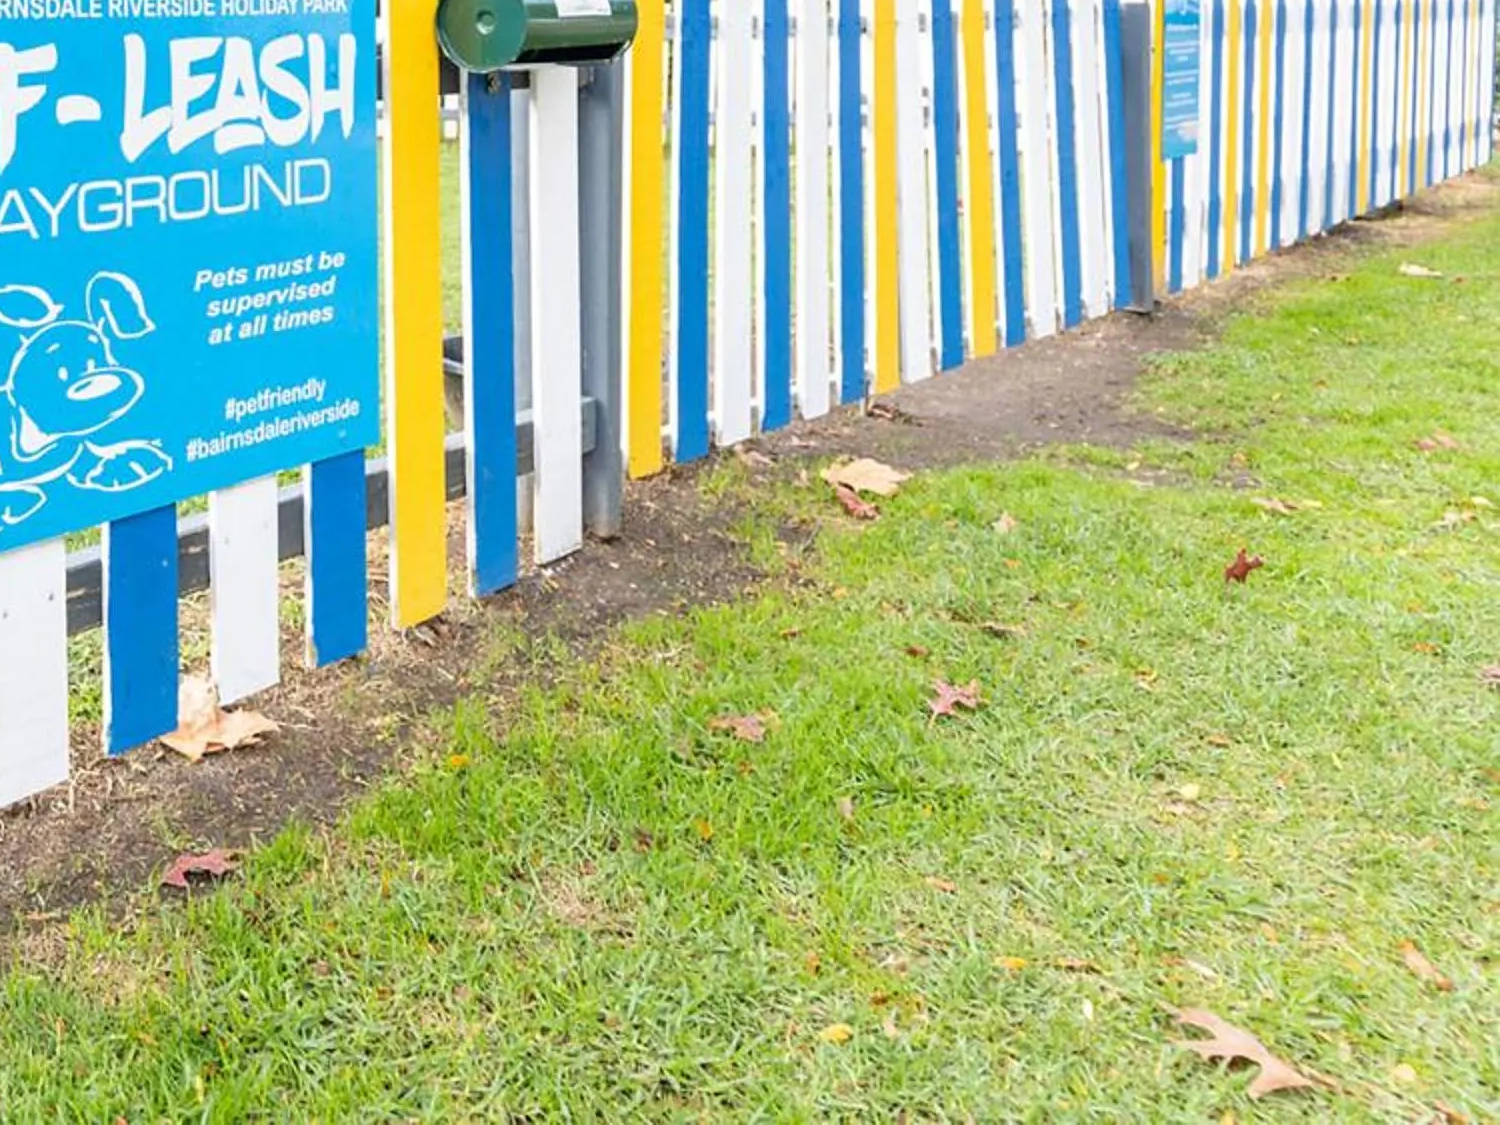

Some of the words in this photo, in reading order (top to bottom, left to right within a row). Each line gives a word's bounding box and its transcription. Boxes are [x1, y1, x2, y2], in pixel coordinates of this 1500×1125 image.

[194, 266, 248, 292] Pets
[255, 254, 314, 281] must
[318, 250, 346, 270] be
[206, 275, 337, 317] supervised
[208, 323, 233, 345] at
[238, 314, 268, 339] all
[273, 306, 334, 332] times
[225, 378, 326, 422] #petfriendly
[186, 398, 360, 462] #bairnsdaleriverside
